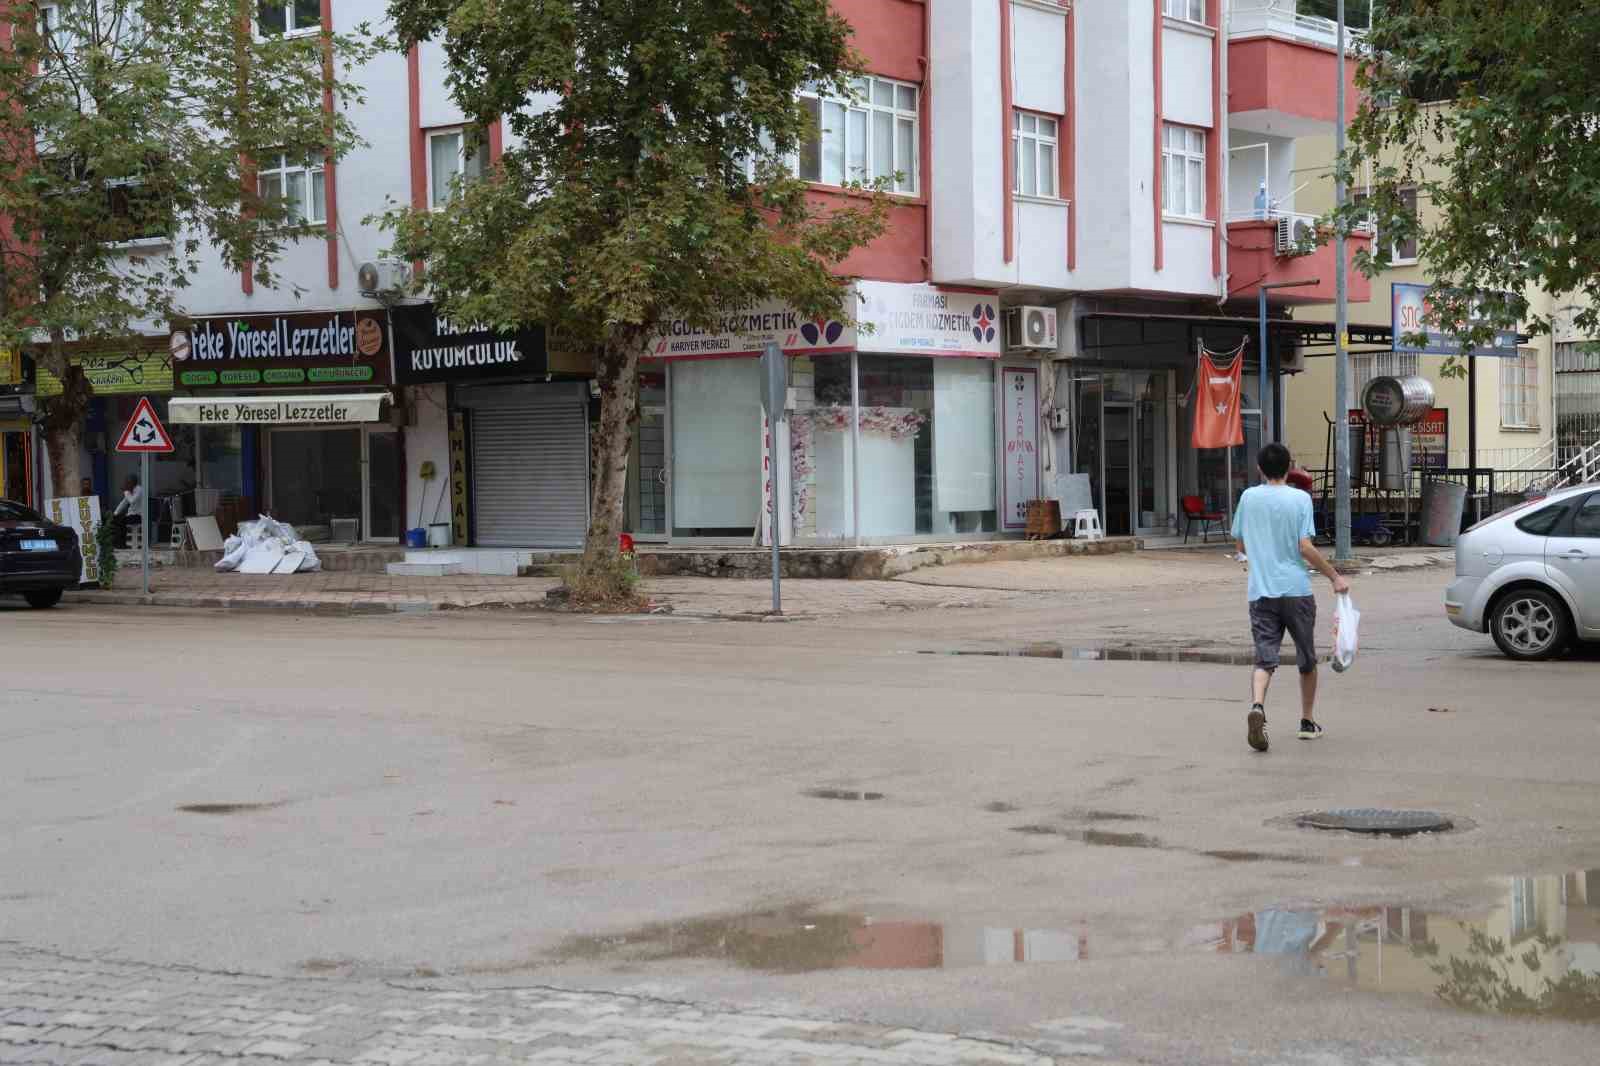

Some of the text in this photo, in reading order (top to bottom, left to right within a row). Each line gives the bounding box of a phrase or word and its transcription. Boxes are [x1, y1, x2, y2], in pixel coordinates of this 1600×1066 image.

[283, 314, 355, 357] Lezzetler
[411, 340, 519, 371] KUYUMCULUK
[199, 402, 348, 422] Feke Yöresel Lezzetler
